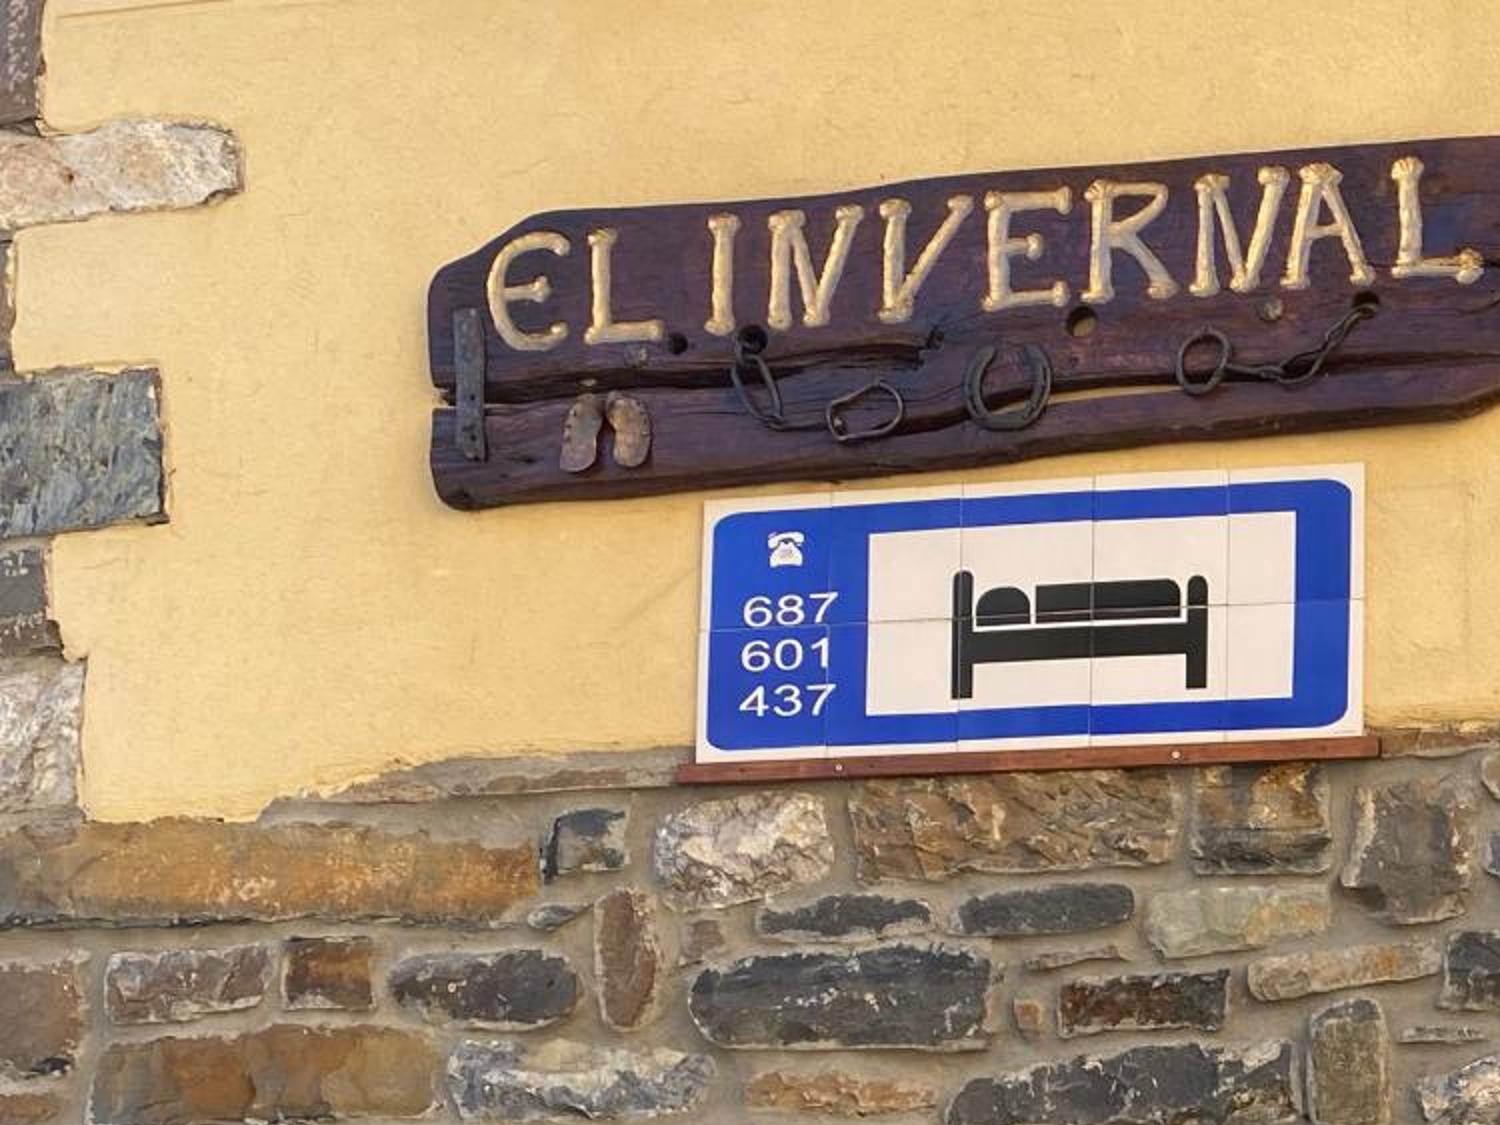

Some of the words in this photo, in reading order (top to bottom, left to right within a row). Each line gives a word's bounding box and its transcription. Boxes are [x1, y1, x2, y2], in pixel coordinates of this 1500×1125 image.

[486, 228, 666, 352] EL
[702, 156, 1485, 337] INVERNAL
[742, 591, 839, 628] 687
[740, 636, 830, 673] 601
[738, 683, 837, 718] 437
